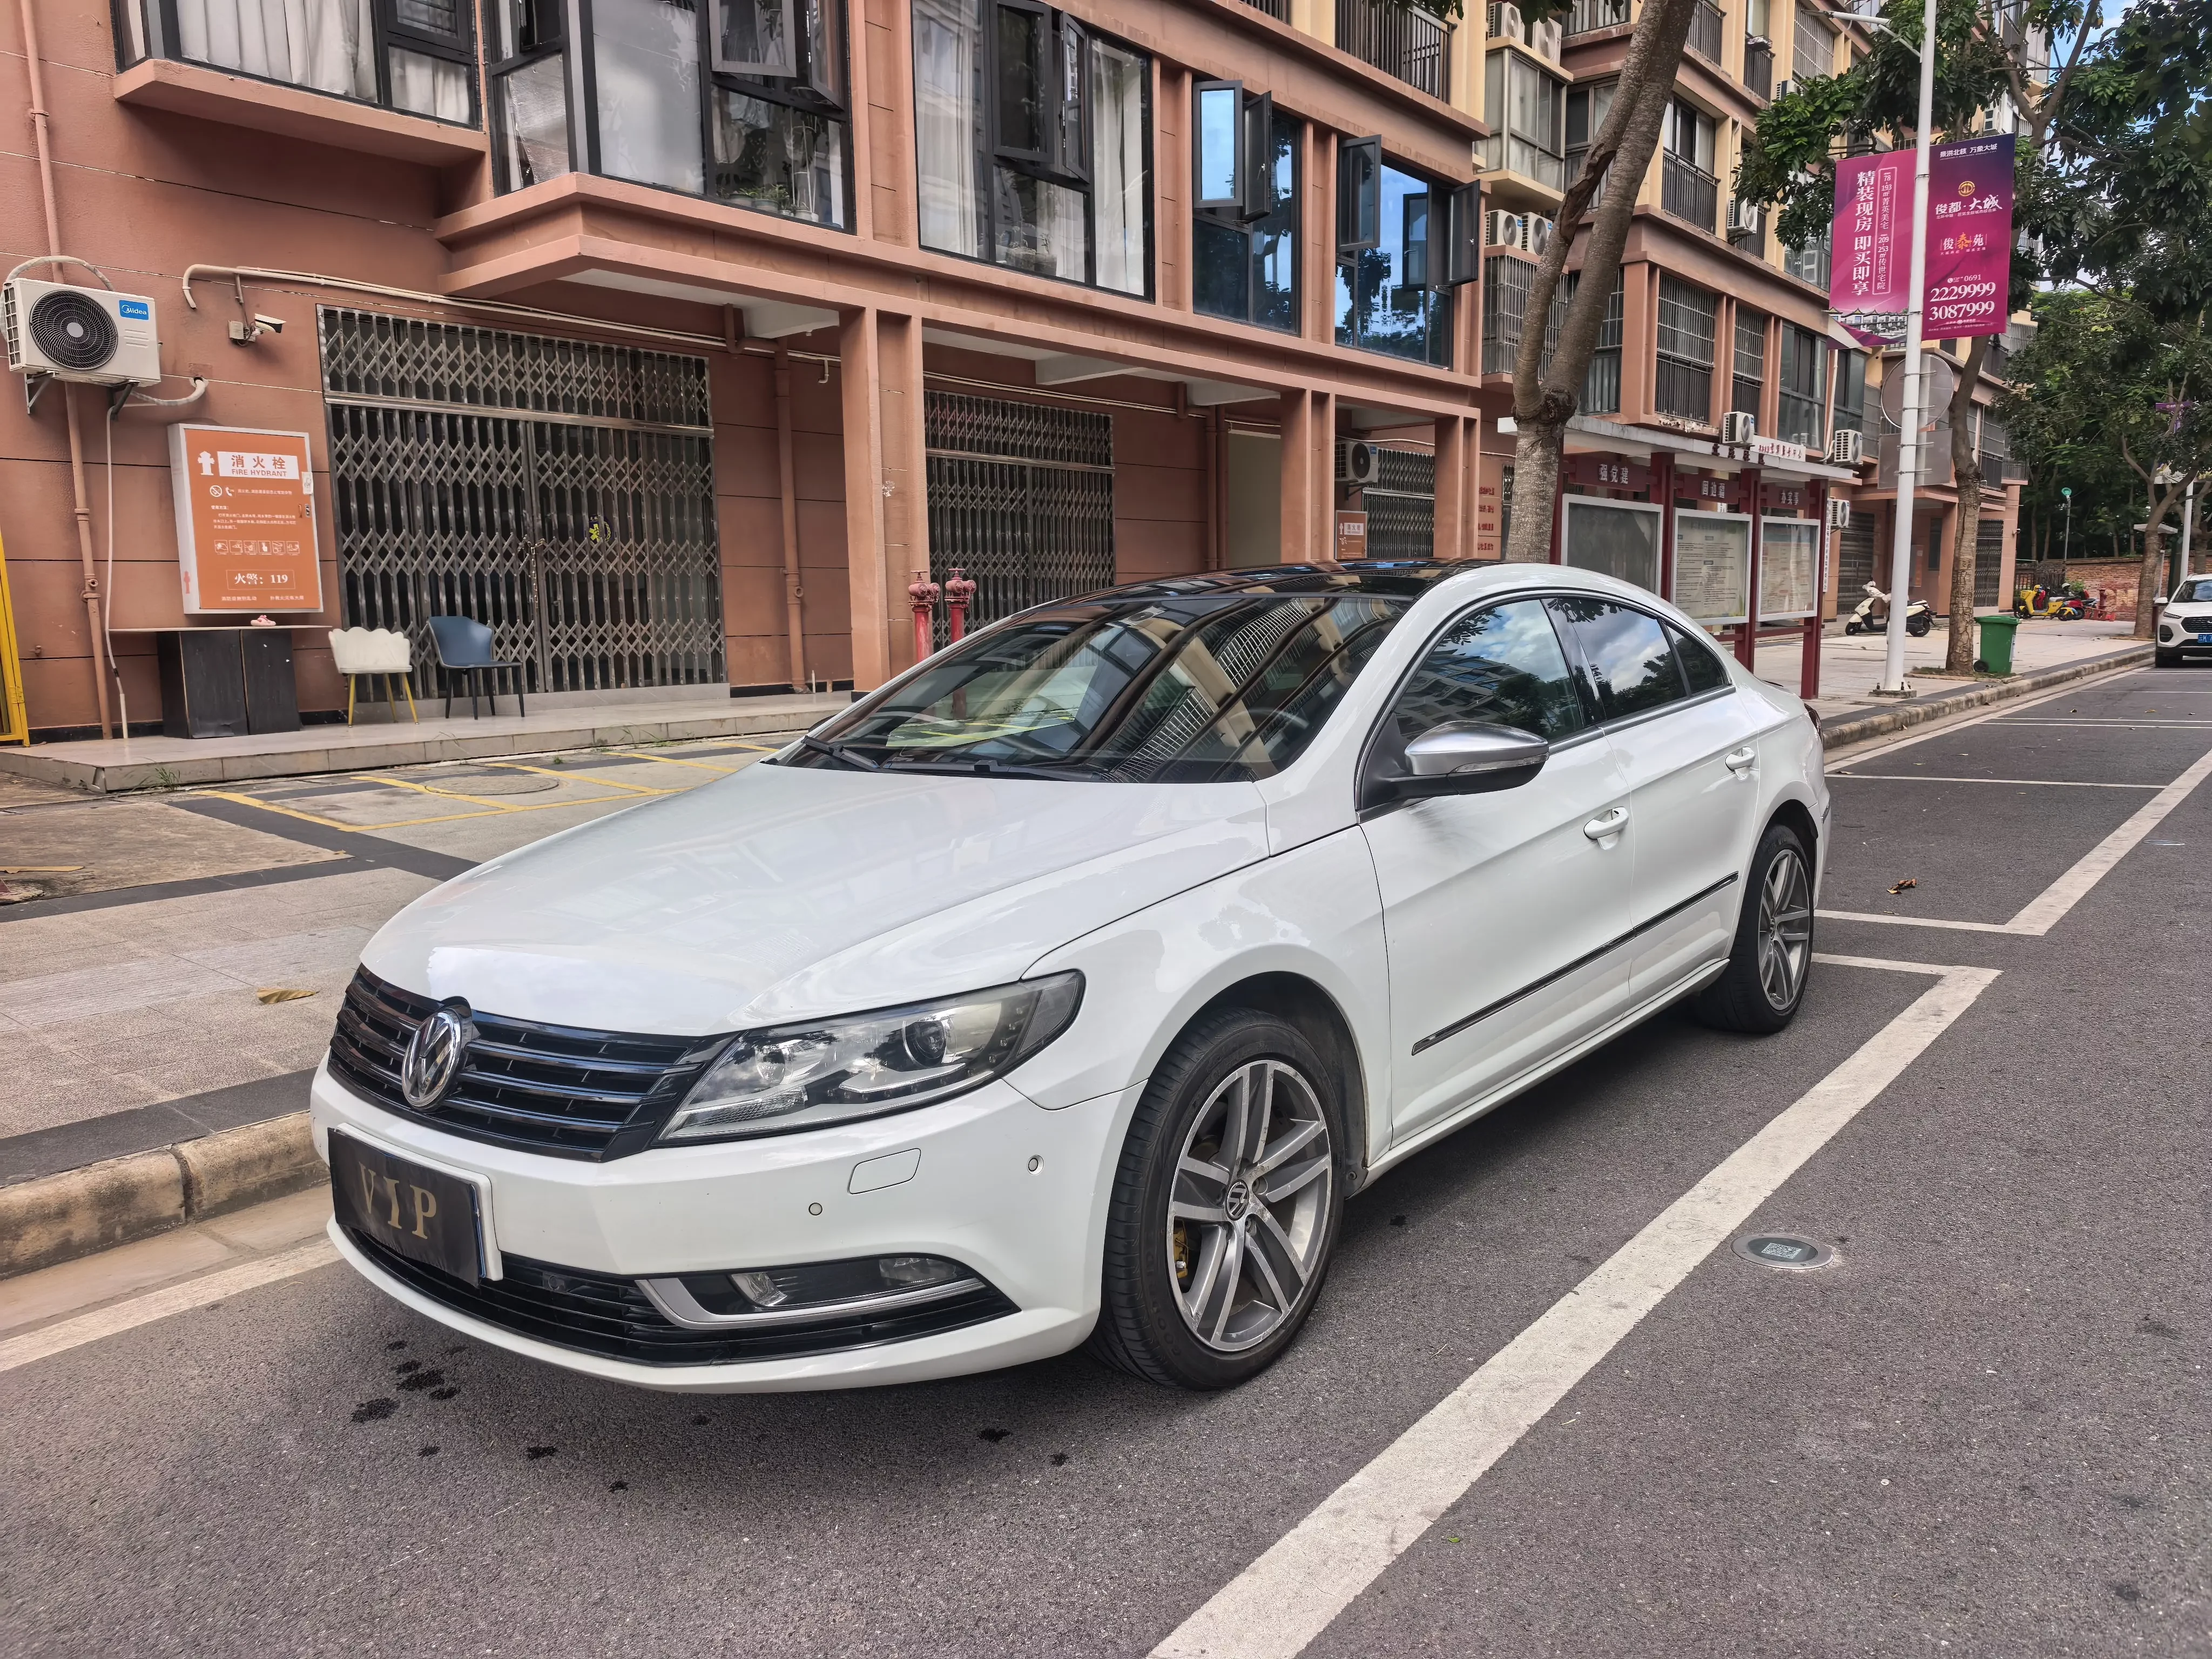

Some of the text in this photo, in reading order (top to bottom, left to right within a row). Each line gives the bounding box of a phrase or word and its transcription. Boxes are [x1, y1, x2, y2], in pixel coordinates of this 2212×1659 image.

[1969, 143, 1998, 154] 万象大城
[1851, 171, 1876, 295] 精装现房 即买即享
[1943, 232, 1984, 251] 俊泰苑
[1930, 282, 1996, 302] 2229999
[122, 305, 147, 315] Midea
[1928, 301, 1995, 320] 3087999
[231, 455, 286, 469] 消火栓
[270, 574, 288, 583] 119
[358, 1161, 437, 1240] VIP
